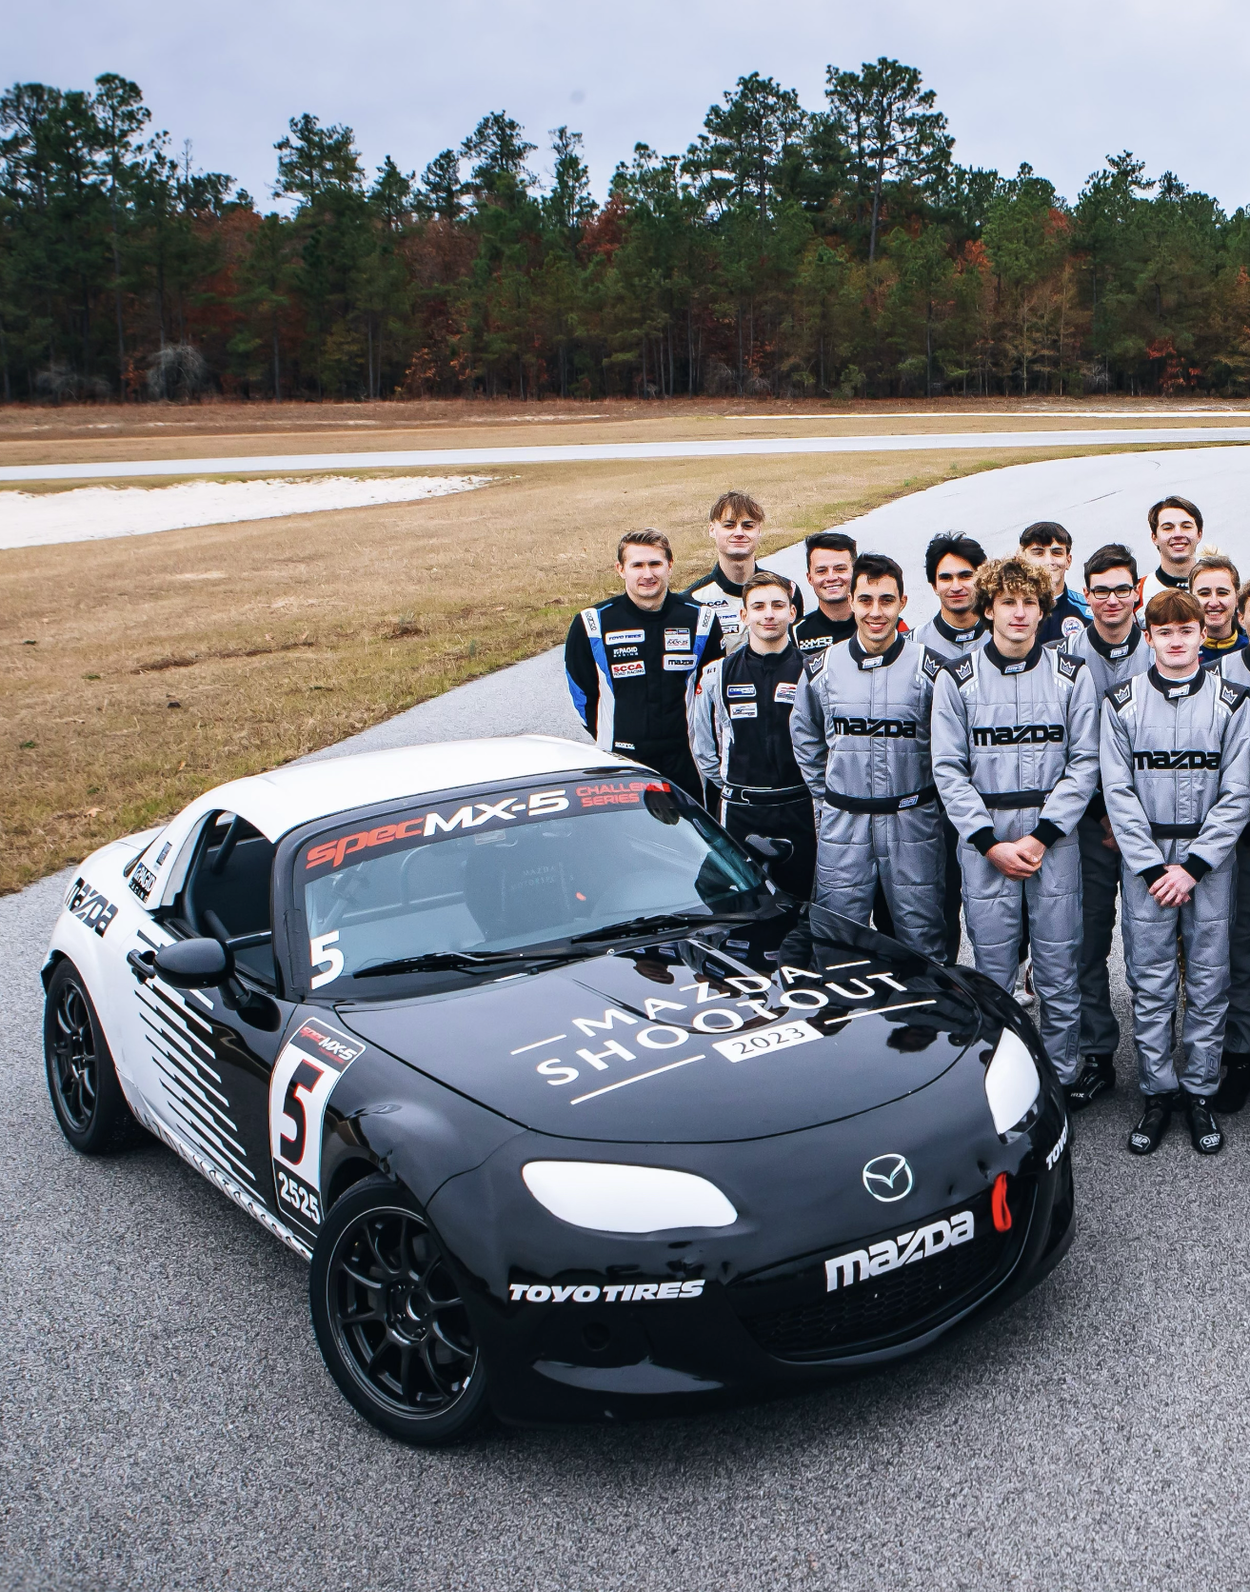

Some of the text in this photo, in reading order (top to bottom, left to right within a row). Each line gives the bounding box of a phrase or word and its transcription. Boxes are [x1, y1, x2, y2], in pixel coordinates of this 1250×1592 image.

[613, 664, 643, 672] SCCA
[833, 717, 917, 738] mazda
[972, 724, 1064, 746] mazda
[1133, 750, 1221, 770] mazda
[581, 792, 640, 808] SERIES
[65, 877, 118, 938] mazda
[310, 931, 346, 990] 5
[573, 965, 823, 1038] MAZDA
[536, 972, 908, 1086] SHOOTOUT
[735, 1027, 806, 1054] 2023
[280, 1058, 324, 1166] 5
[279, 1171, 321, 1226] 2525
[825, 1210, 974, 1292] mazda
[509, 1280, 705, 1302] TOYO TIRES
